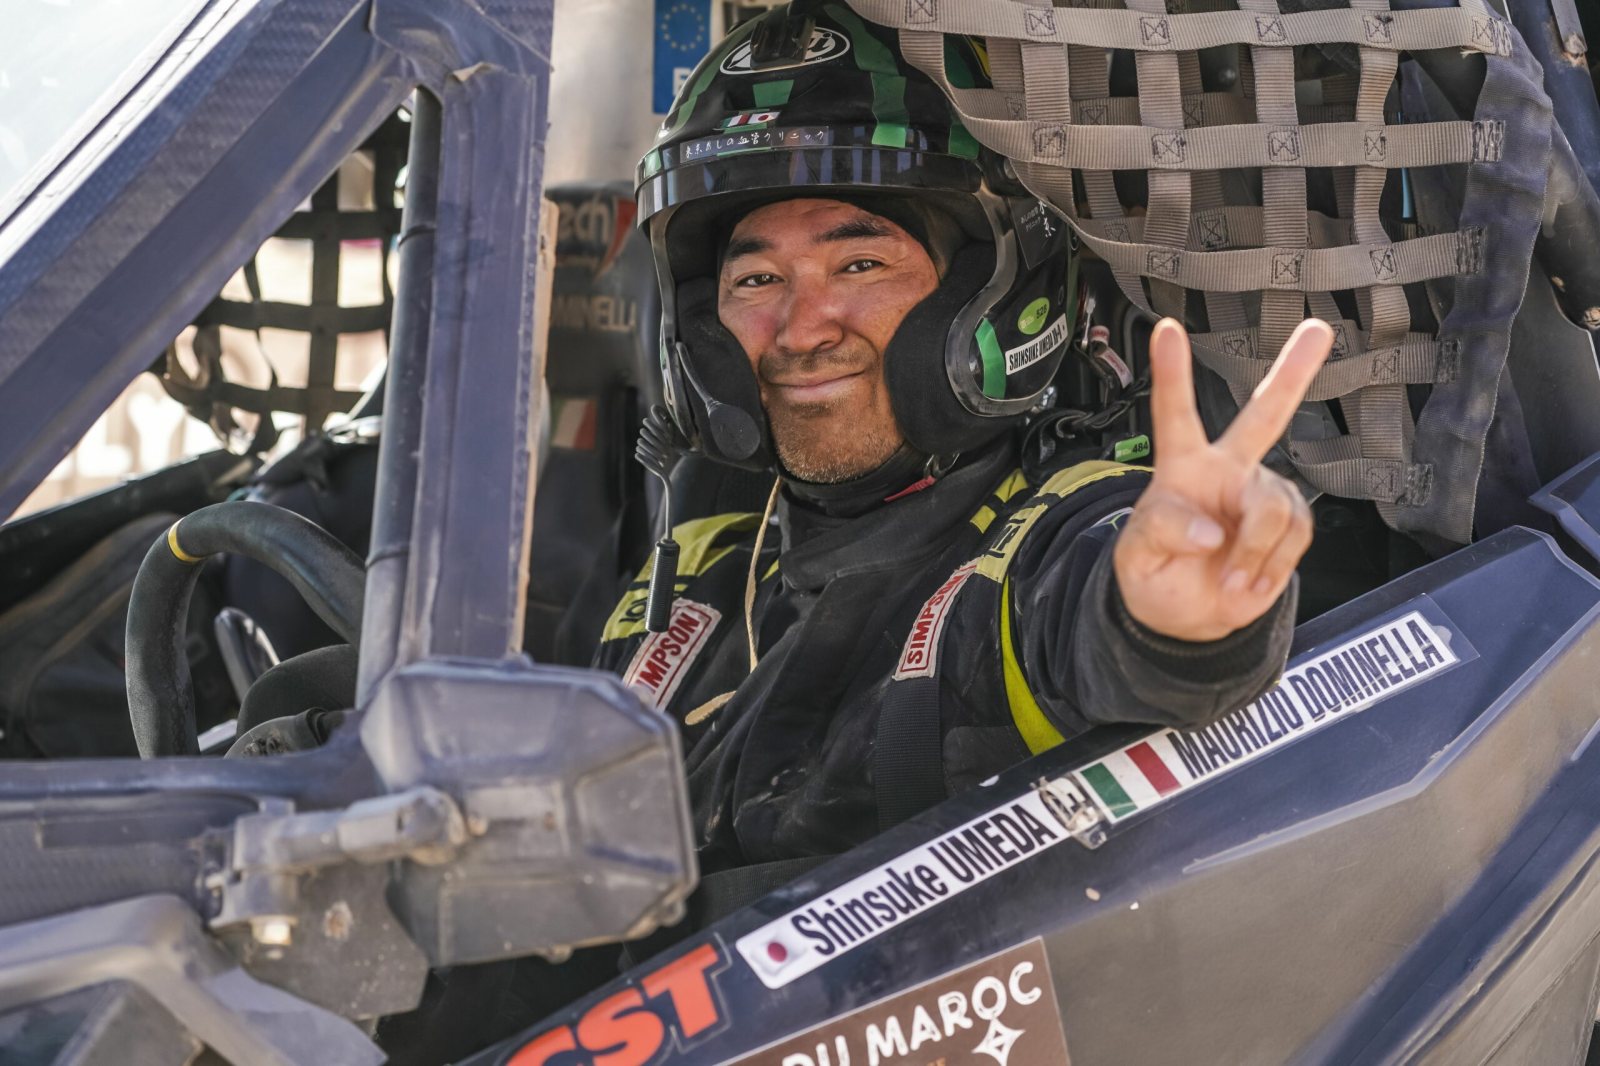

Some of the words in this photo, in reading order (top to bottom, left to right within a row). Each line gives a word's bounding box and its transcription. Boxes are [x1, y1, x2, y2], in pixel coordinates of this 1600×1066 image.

[635, 611, 701, 695] IMPSON
[906, 574, 965, 665] SIMPSON
[1287, 619, 1445, 723] DOMINELLA
[791, 863, 949, 956] Shinsuke
[927, 803, 1059, 884] UMEDA
[866, 961, 1042, 1066] MAROC
